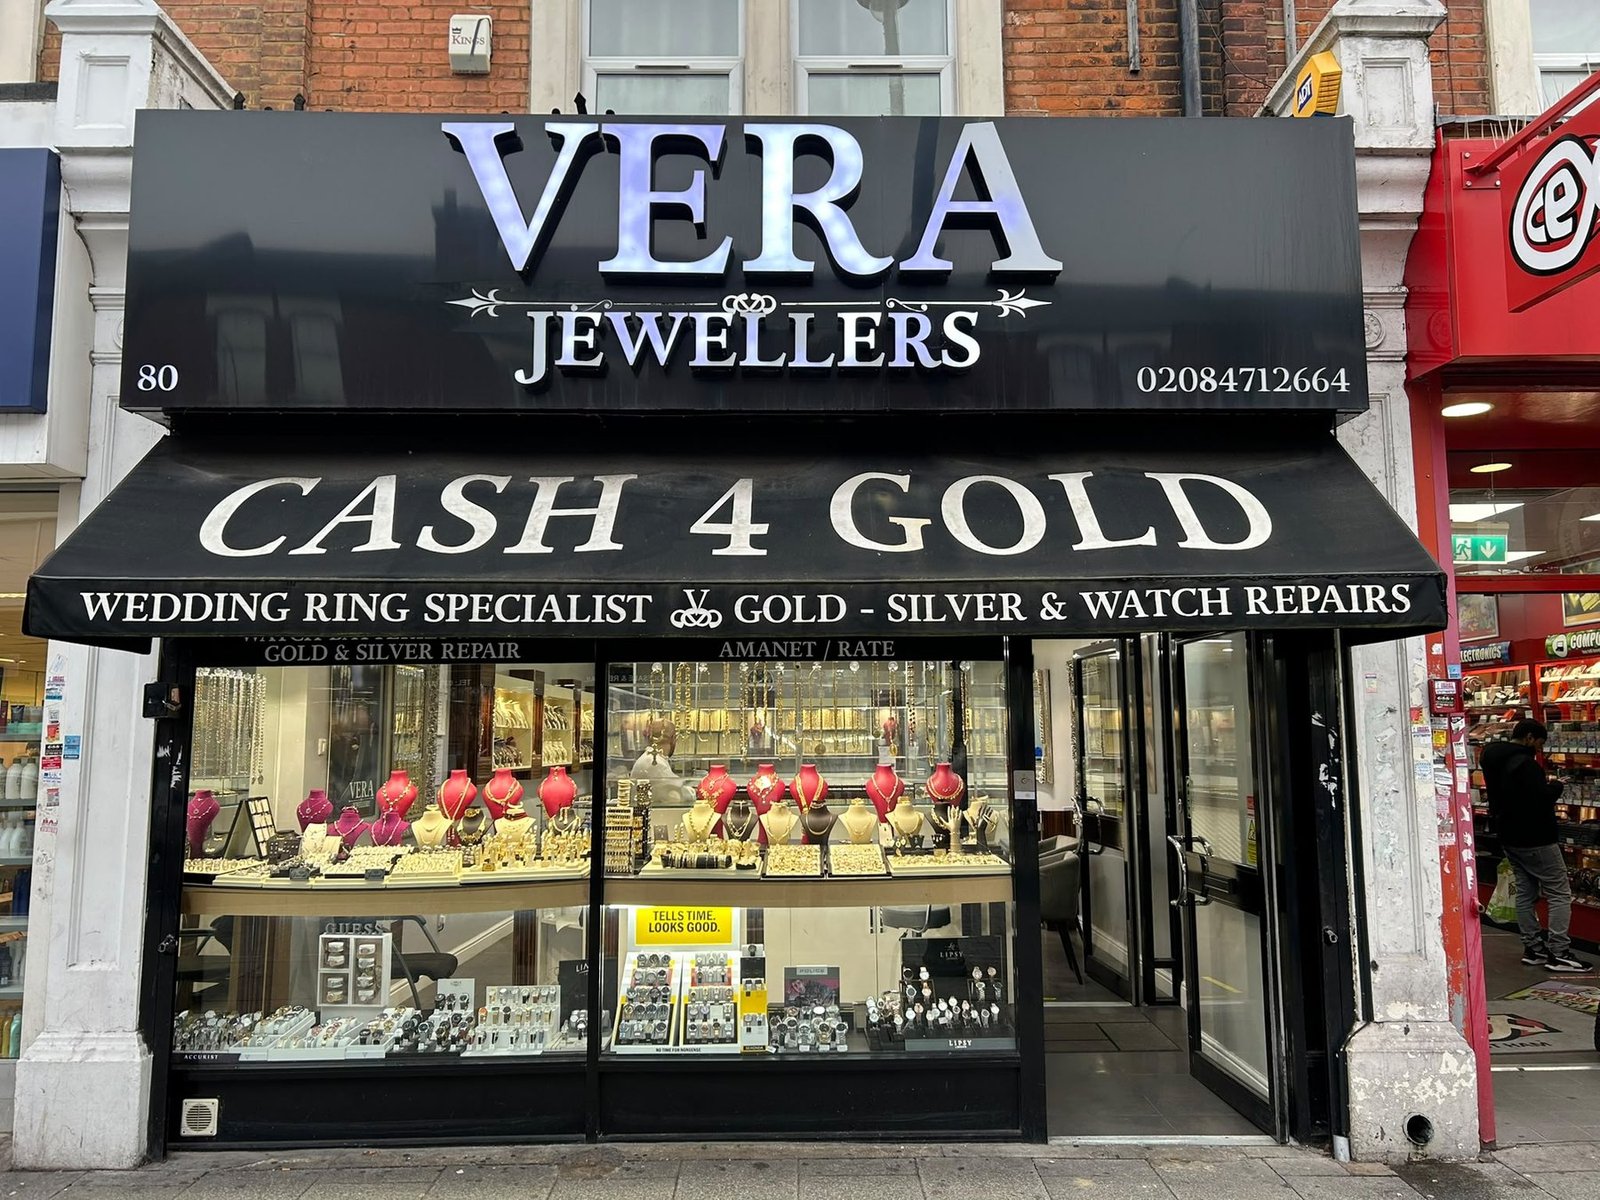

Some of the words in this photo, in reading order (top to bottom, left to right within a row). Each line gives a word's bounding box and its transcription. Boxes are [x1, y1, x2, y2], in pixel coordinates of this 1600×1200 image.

[1298, 77, 1313, 106] ADT
[440, 121, 1064, 276] VERA
[514, 311, 982, 386] JEWELLERS
[137, 364, 179, 392] 80
[1136, 366, 1350, 393] 02084712664
[199, 473, 638, 557] CASH
[690, 478, 769, 556] 4
[830, 471, 1273, 555] GOLD
[80, 592, 290, 622] WEDDING
[302, 592, 410, 622] RING
[423, 592, 653, 624] SPECIALIST
[734, 594, 847, 624] GOLD
[887, 592, 1028, 623] SILVER
[1039, 591, 1067, 621] &
[1079, 586, 1233, 620] WATCH
[1243, 583, 1412, 616] REPAIRS
[264, 645, 329, 662] GOLD
[334, 644, 350, 661] &
[355, 643, 434, 661] SILVER
[440, 642, 521, 660] REPAIR
[718, 641, 817, 658] AMANET
[837, 640, 896, 657] RATE
[1460, 645, 1502, 663] LECTRONICS
[349, 779, 375, 799] VERA
[325, 923, 384, 935] GUESS
[648, 922, 684, 933] LOOKS
[686, 922, 720, 933] GOOD.
[653, 911, 684, 921] TELLS
[687, 910, 716, 921] TIME.
